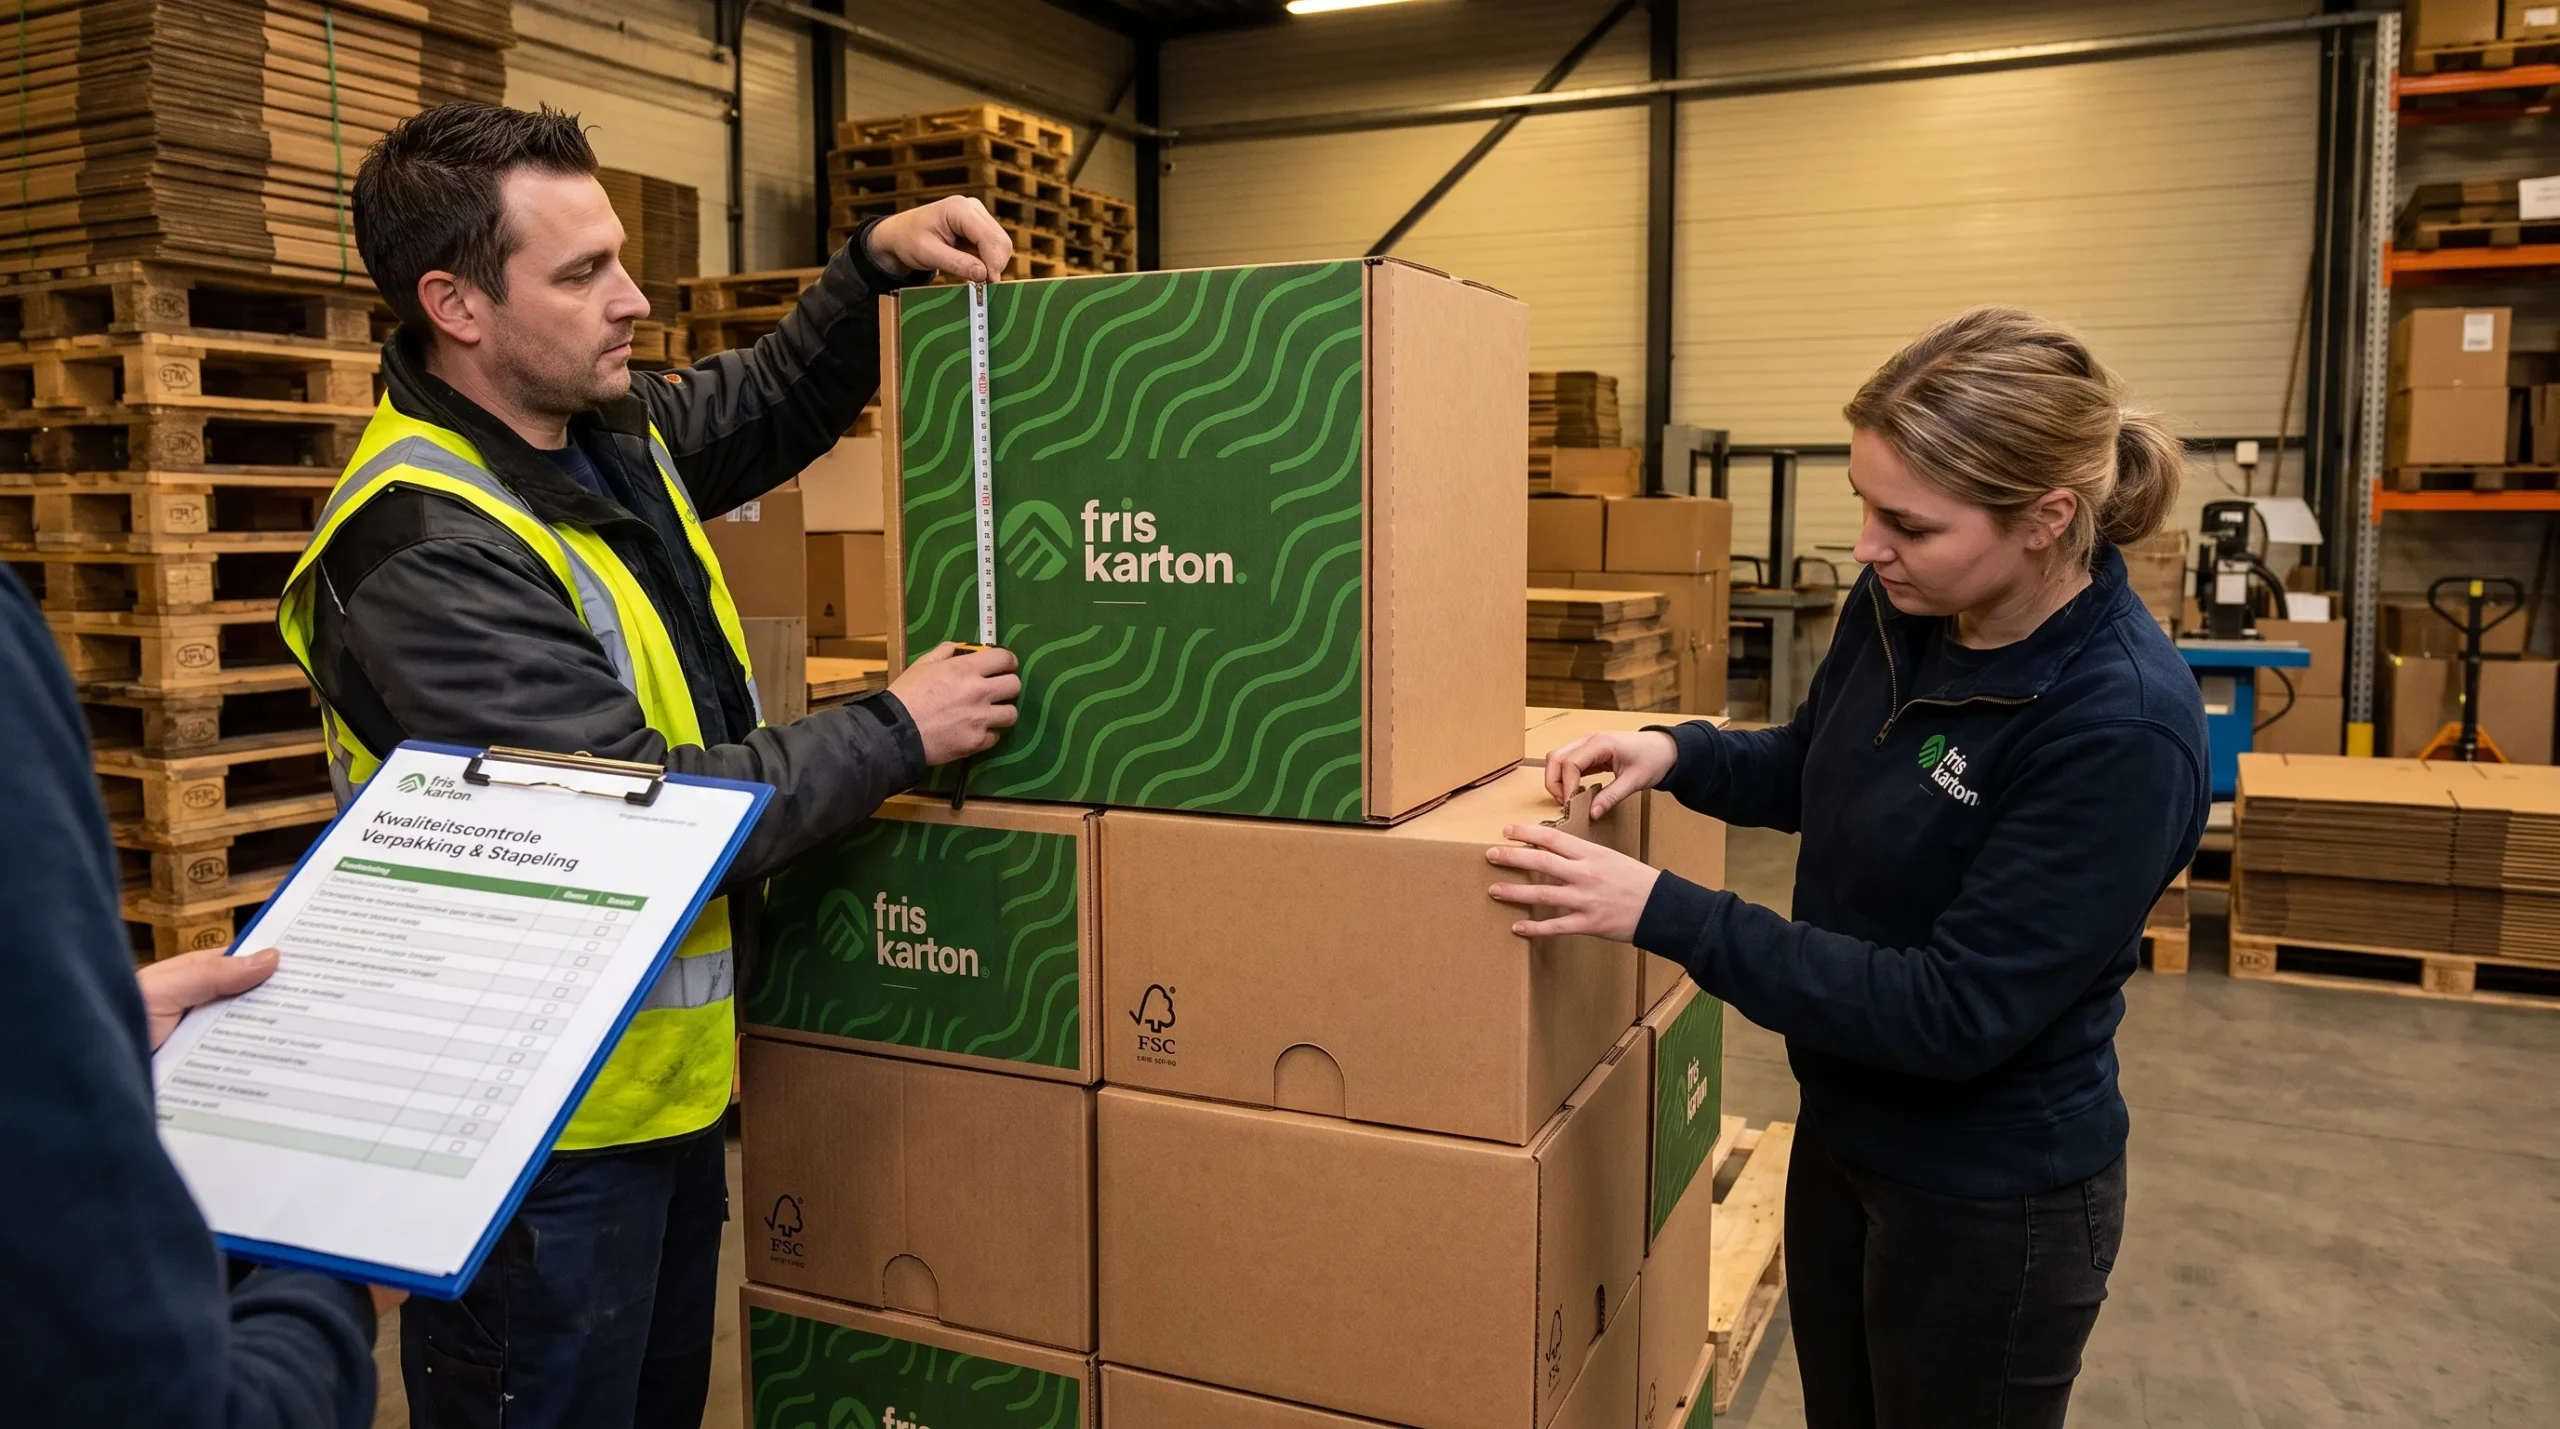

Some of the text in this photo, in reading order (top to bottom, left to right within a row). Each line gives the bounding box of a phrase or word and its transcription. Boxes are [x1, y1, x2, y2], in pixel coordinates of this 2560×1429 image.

[1080, 497, 1157, 543] fris
[1942, 746, 1967, 775] fris
[429, 775, 456, 789] fris
[372, 809, 543, 845] Kwaliteitscontrole
[361, 828, 581, 873] Verpakking & Stapeling
[873, 891, 927, 935] fris
[1137, 1034, 1176, 1055] FSC
[769, 1237, 804, 1257] FSC
